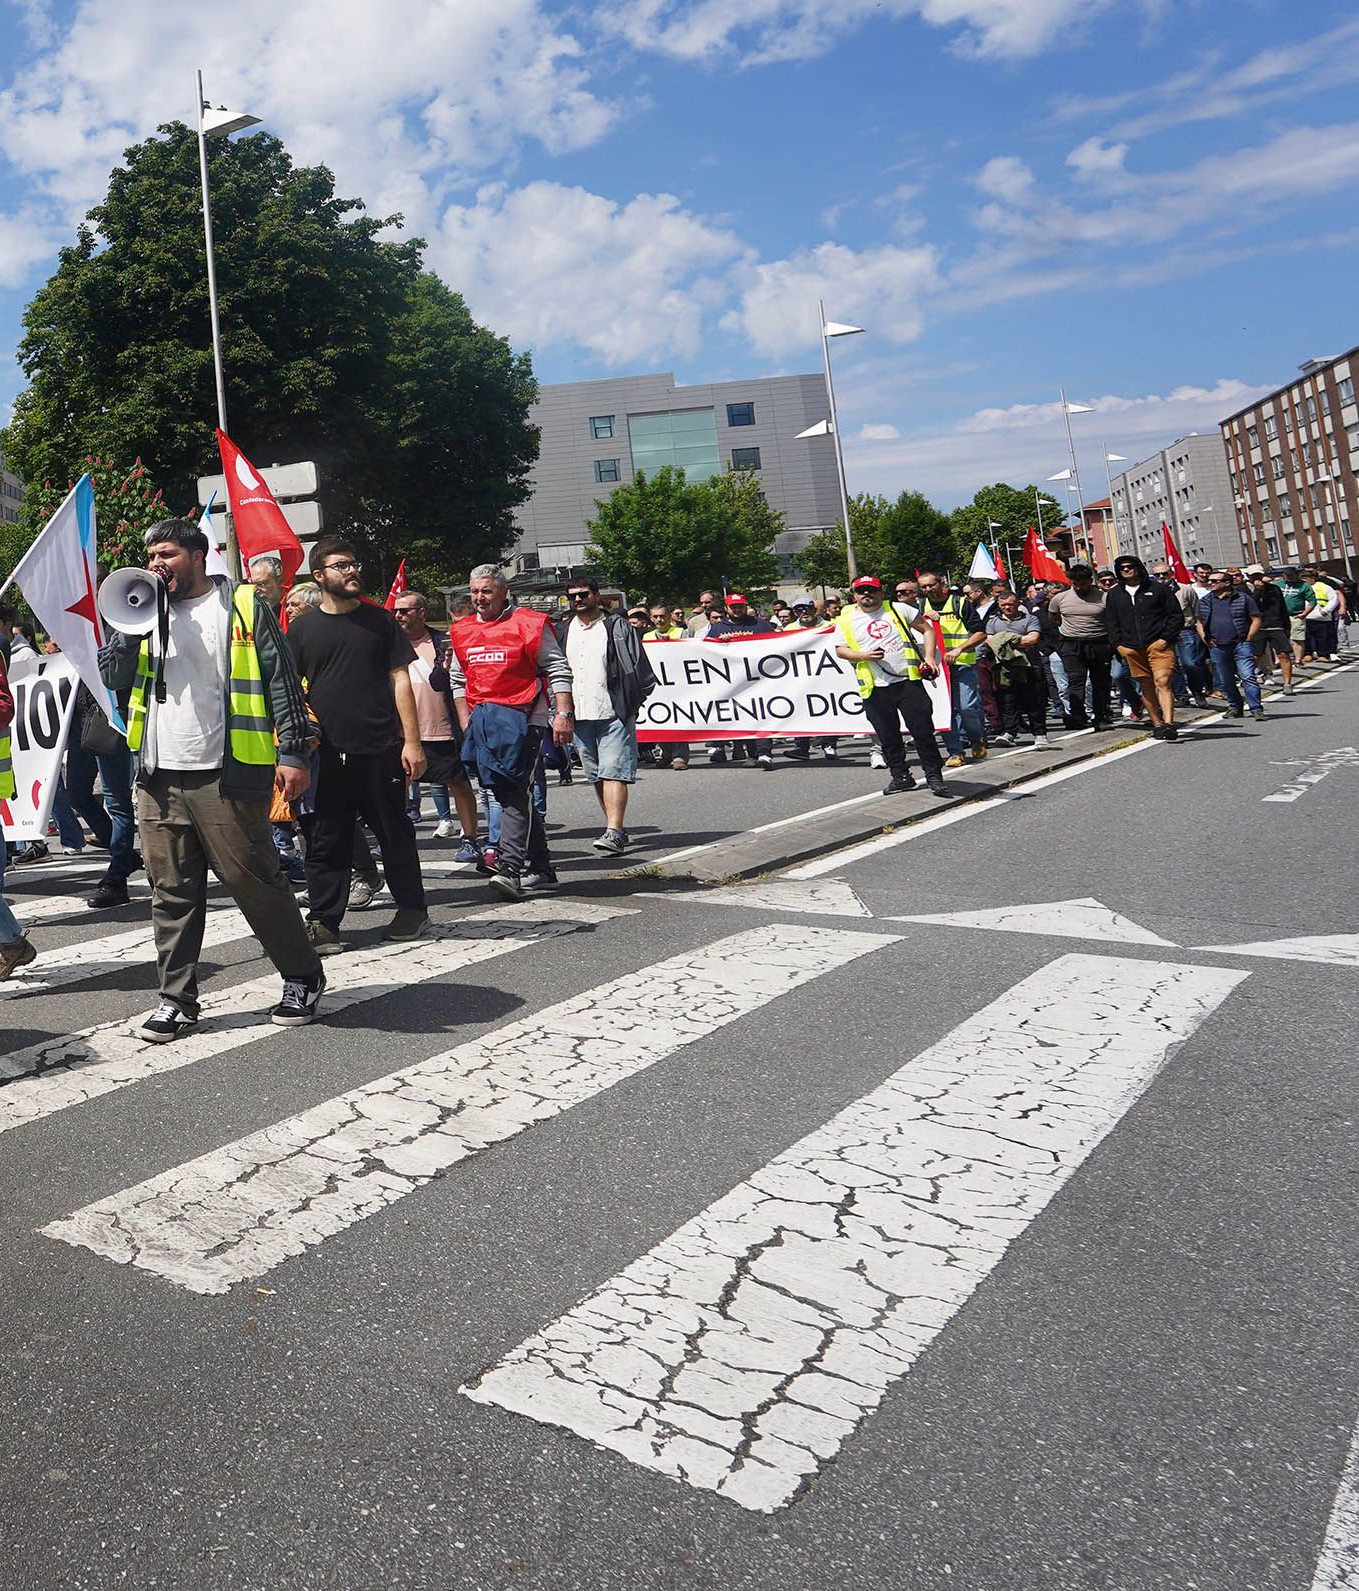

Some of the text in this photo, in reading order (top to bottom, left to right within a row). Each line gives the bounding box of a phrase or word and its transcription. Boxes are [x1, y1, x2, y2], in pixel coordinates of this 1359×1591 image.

[683, 658, 732, 685] EN
[743, 648, 844, 681] LOITA
[806, 691, 865, 718] DIG
